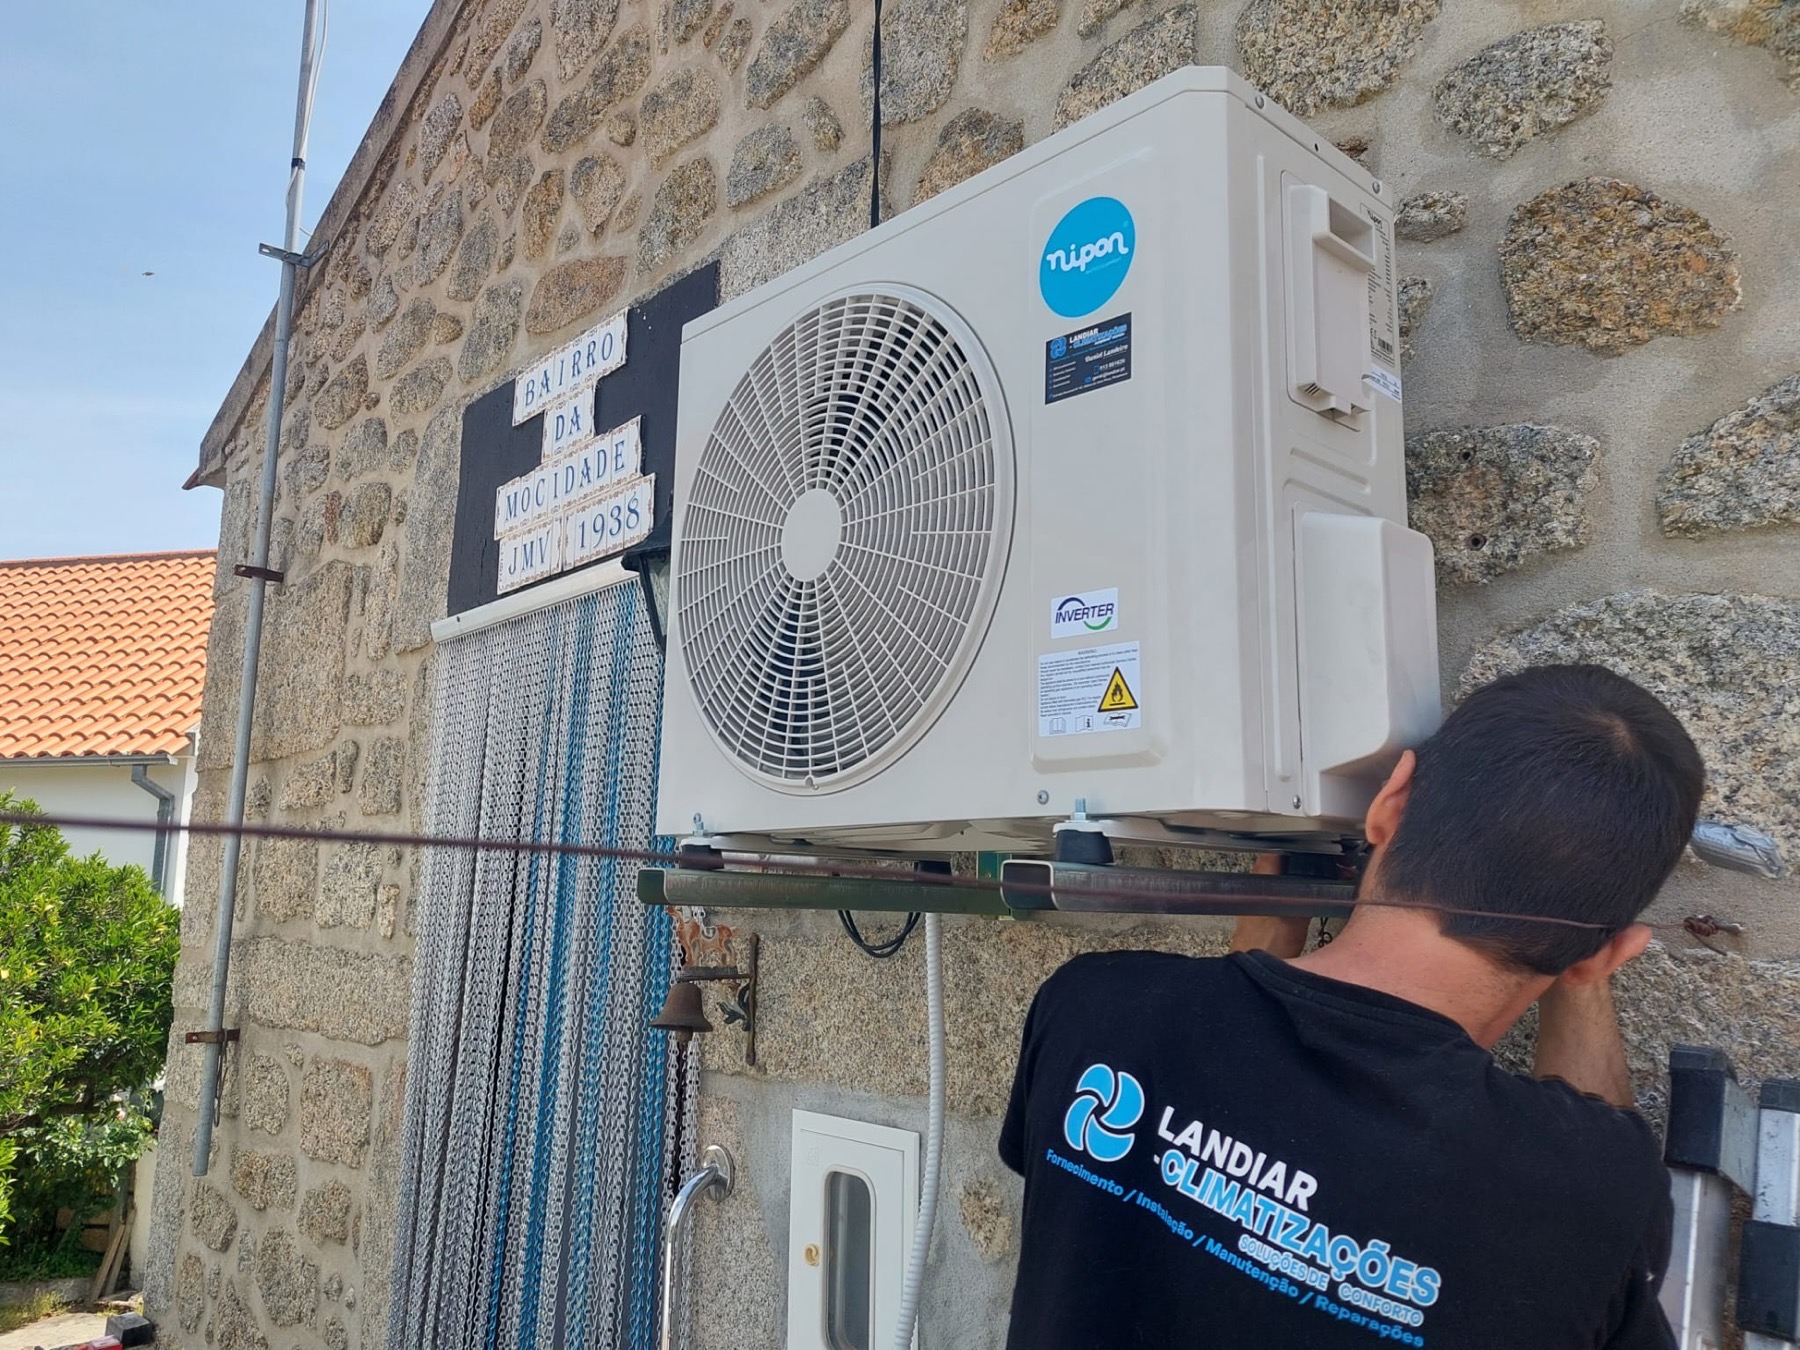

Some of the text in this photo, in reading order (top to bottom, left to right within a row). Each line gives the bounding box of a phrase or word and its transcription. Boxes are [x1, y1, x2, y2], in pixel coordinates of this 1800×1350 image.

[1046, 232, 1129, 272] nipon
[524, 332, 614, 407] BAIRRO
[1069, 328, 1099, 343] LANDIAR
[555, 405, 582, 443] DA
[504, 439, 626, 522] MOCIDADE
[508, 491, 640, 575] JMV 1938
[1055, 603, 1115, 624] INVERTER
[1158, 1105, 1318, 1212] LANDIAR
[1046, 1148, 1124, 1196] Fornecimento
[1136, 1192, 1194, 1240] Instalação
[1205, 1238, 1299, 1298] Manutenção
[1314, 1294, 1425, 1348] Reparações
[1161, 1149, 1441, 1306] CLIMATIZAÇÕES
[1238, 1234, 1424, 1327] SOLUÇÕES DE CONFORTO
